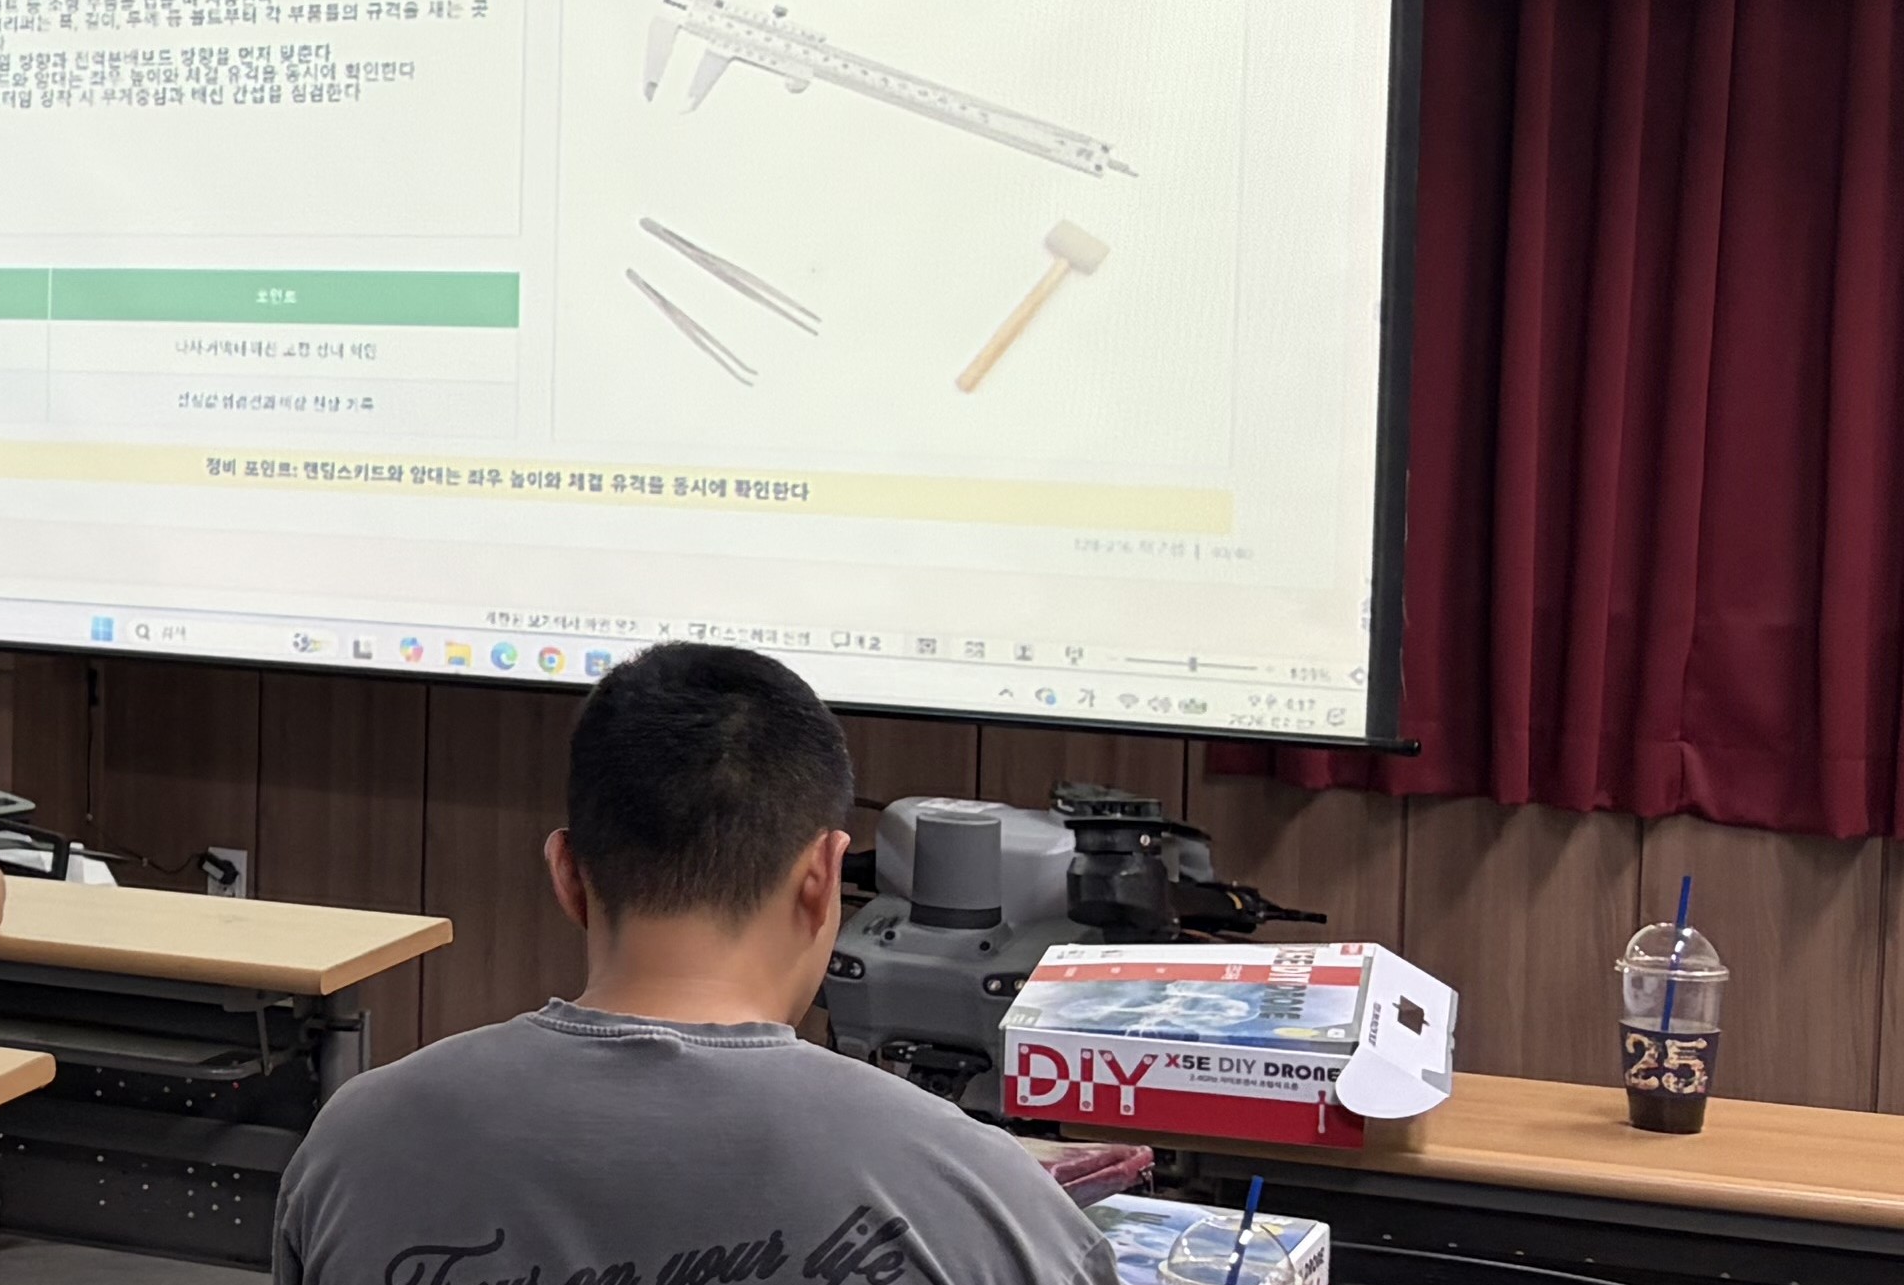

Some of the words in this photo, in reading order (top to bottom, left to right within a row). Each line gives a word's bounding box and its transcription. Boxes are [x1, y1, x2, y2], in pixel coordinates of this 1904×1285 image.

[1017, 1042, 1158, 1116] DIY
[1165, 1053, 1211, 1071] X5E
[1219, 1057, 1256, 1075] DIY
[1264, 1062, 1341, 1082] DRONE
[1625, 1032, 1708, 1094] 25
